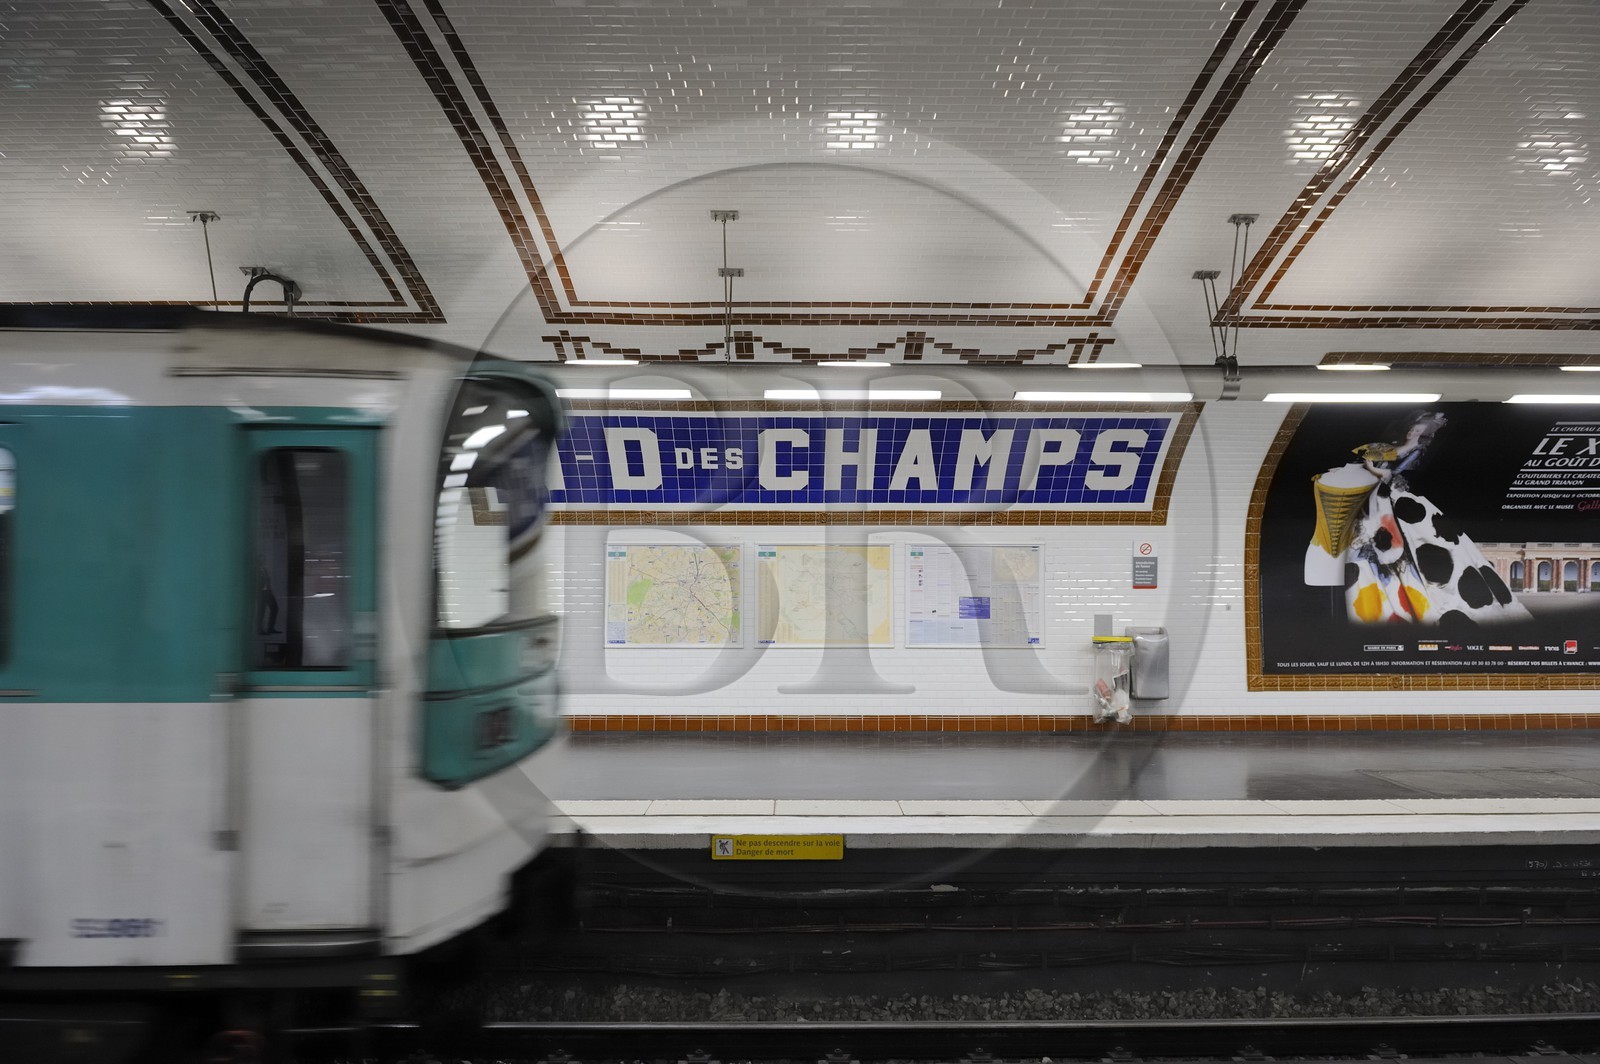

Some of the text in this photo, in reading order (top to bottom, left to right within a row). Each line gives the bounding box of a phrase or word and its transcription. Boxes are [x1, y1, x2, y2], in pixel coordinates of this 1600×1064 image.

[1532, 438, 1574, 455] LE
[675, 447, 743, 470] DES
[758, 428, 1149, 490] CHAMPS
[1523, 459, 1542, 467] AU
[1544, 456, 1589, 467] GOÛT
[736, 849, 762, 857] Danger
